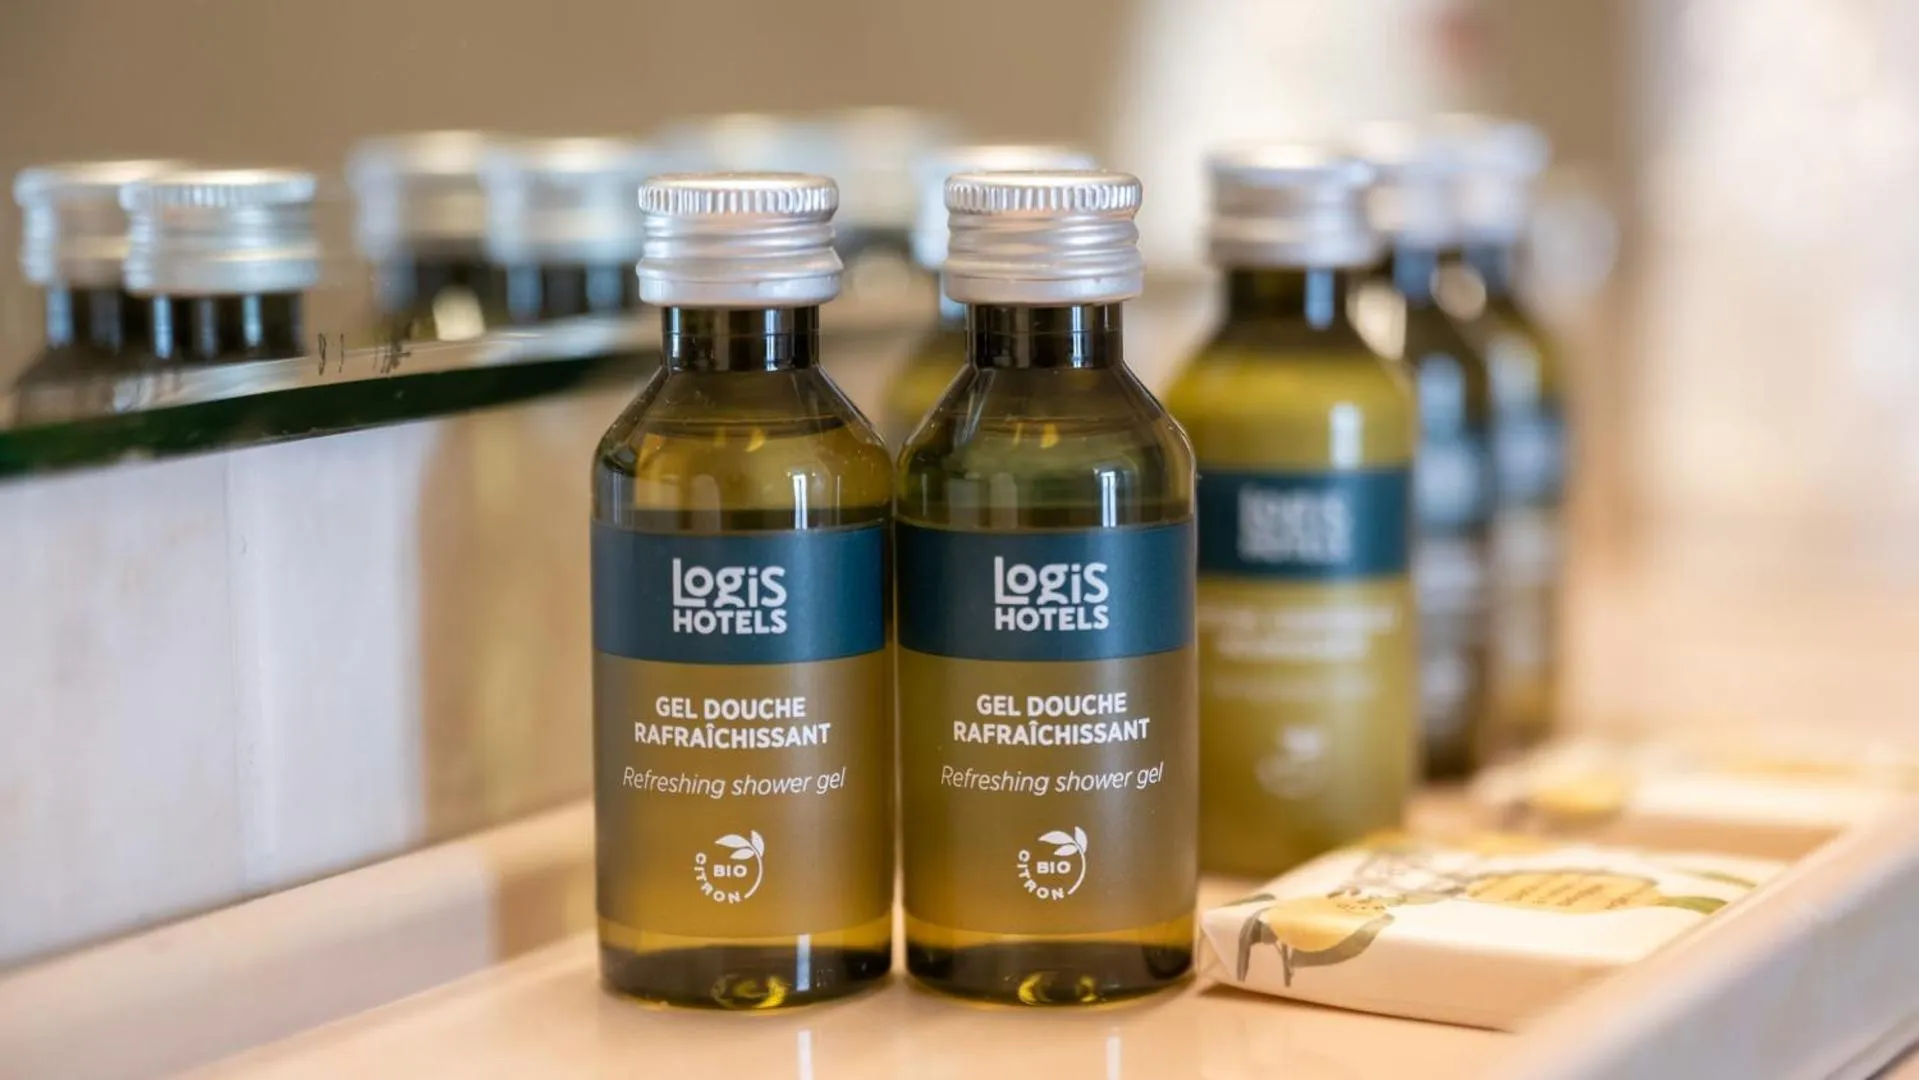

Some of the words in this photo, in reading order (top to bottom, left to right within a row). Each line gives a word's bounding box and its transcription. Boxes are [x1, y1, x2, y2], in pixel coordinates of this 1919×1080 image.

[672, 557, 788, 608] Logis
[993, 555, 1109, 605] Logis
[673, 608, 788, 635] HOTELS
[994, 606, 1110, 632] HOTELS
[655, 696, 698, 719] GEL
[703, 696, 806, 720] DOUCHE
[976, 694, 1021, 717] GEL
[1026, 692, 1128, 717] DOUCHE
[634, 721, 831, 750] RAFRAÎCHISSANT
[953, 717, 1150, 746] RAFRAÎCHISSANT
[622, 765, 725, 800] Refreshing
[731, 774, 813, 797] shower
[815, 766, 847, 796] gel
[940, 764, 1049, 796] Refreshing
[1055, 771, 1133, 793] shower
[1136, 761, 1165, 790] gel
[693, 851, 742, 904] CITRON
[713, 863, 748, 878] BIO
[1036, 860, 1072, 874] BIO
